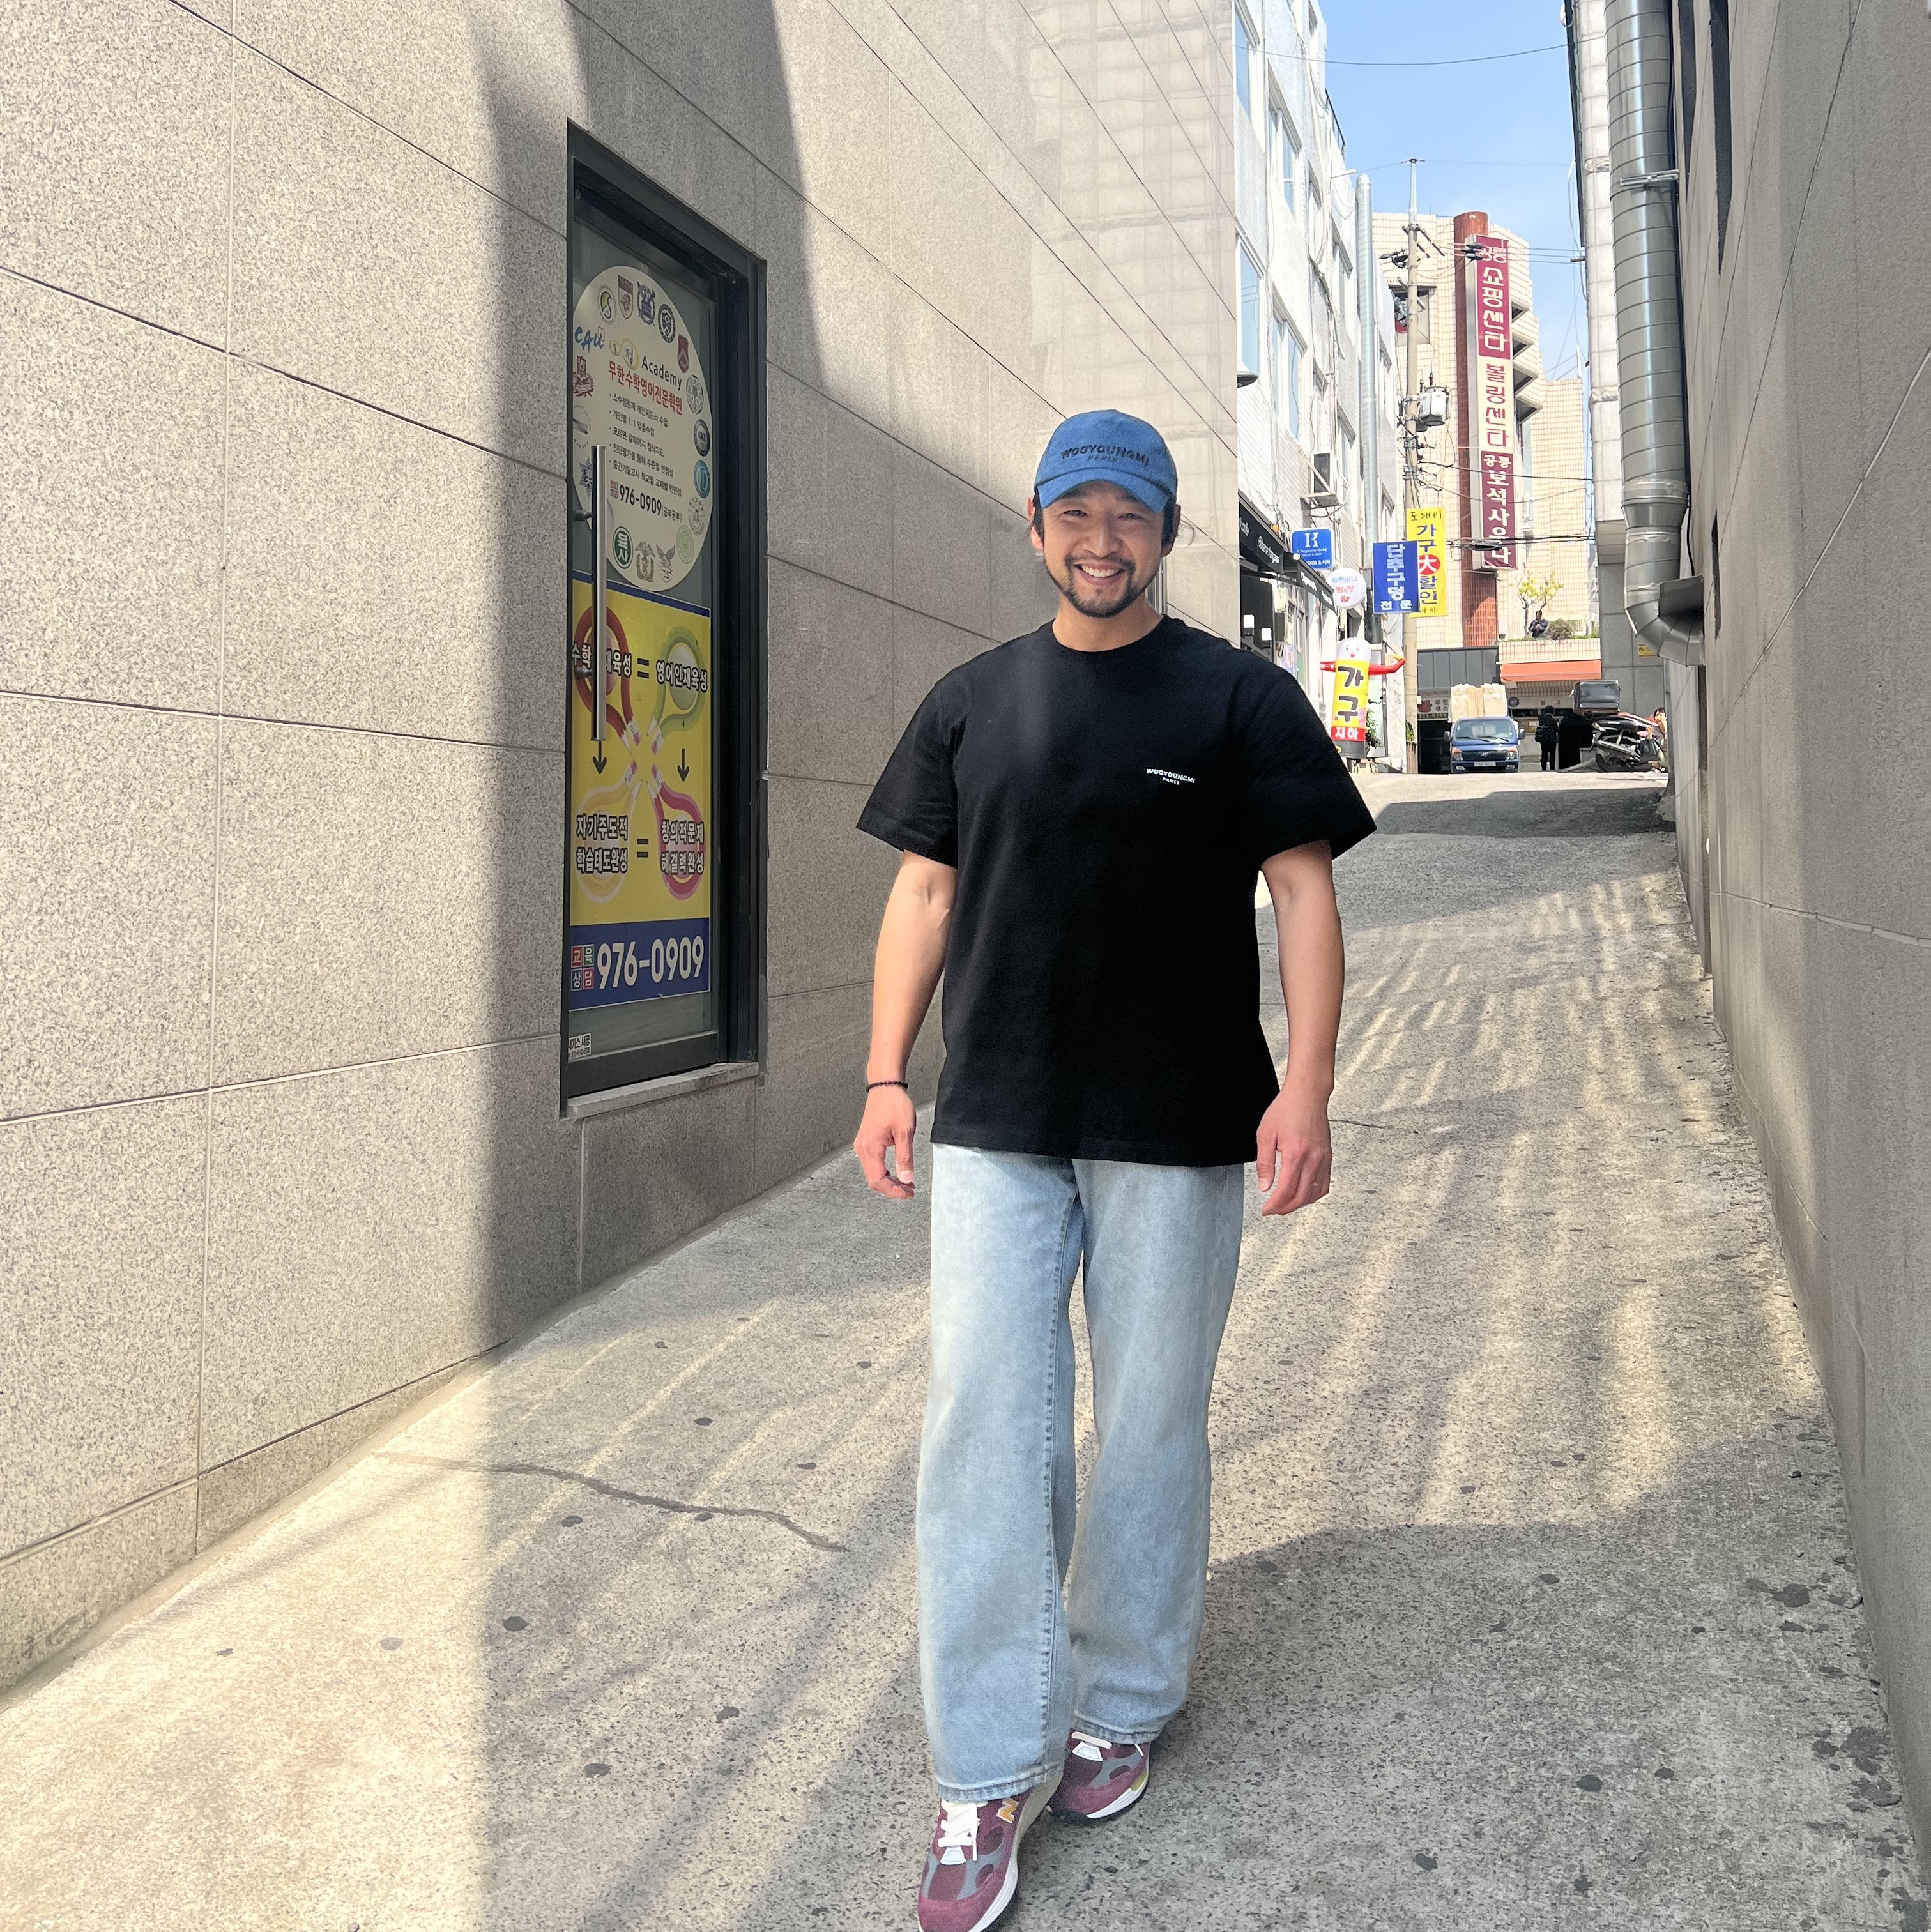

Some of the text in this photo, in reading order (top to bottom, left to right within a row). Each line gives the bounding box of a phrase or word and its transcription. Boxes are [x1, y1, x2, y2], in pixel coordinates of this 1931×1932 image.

[1482, 266, 1507, 352] 쇼핑센타
[574, 326, 605, 353] CAU
[608, 360, 682, 416] 무한수학영어전문학원
[641, 354, 682, 391] Academy
[1485, 363, 1509, 447] 볼링센타
[613, 427, 627, 441] 모르면
[1061, 445, 1150, 467] WOOYOUNGMI
[1486, 469, 1511, 565] 보석사우나
[1386, 544, 1407, 601] 단추구멍
[1380, 600, 1413, 611] 전문
[572, 641, 708, 693] 수학육성 영어인재육성
[1338, 666, 1364, 722] 가구
[1335, 727, 1359, 740] 지하
[1146, 768, 1196, 783] WOOYOUNGMI
[1162, 777, 1180, 785] PARIS
[576, 814, 705, 845] 자기주도적 창의적문제
[576, 847, 705, 875] 학습태도완성 해결력완성
[572, 935, 705, 990] 교육 976-0909
[572, 970, 593, 988] 상담
